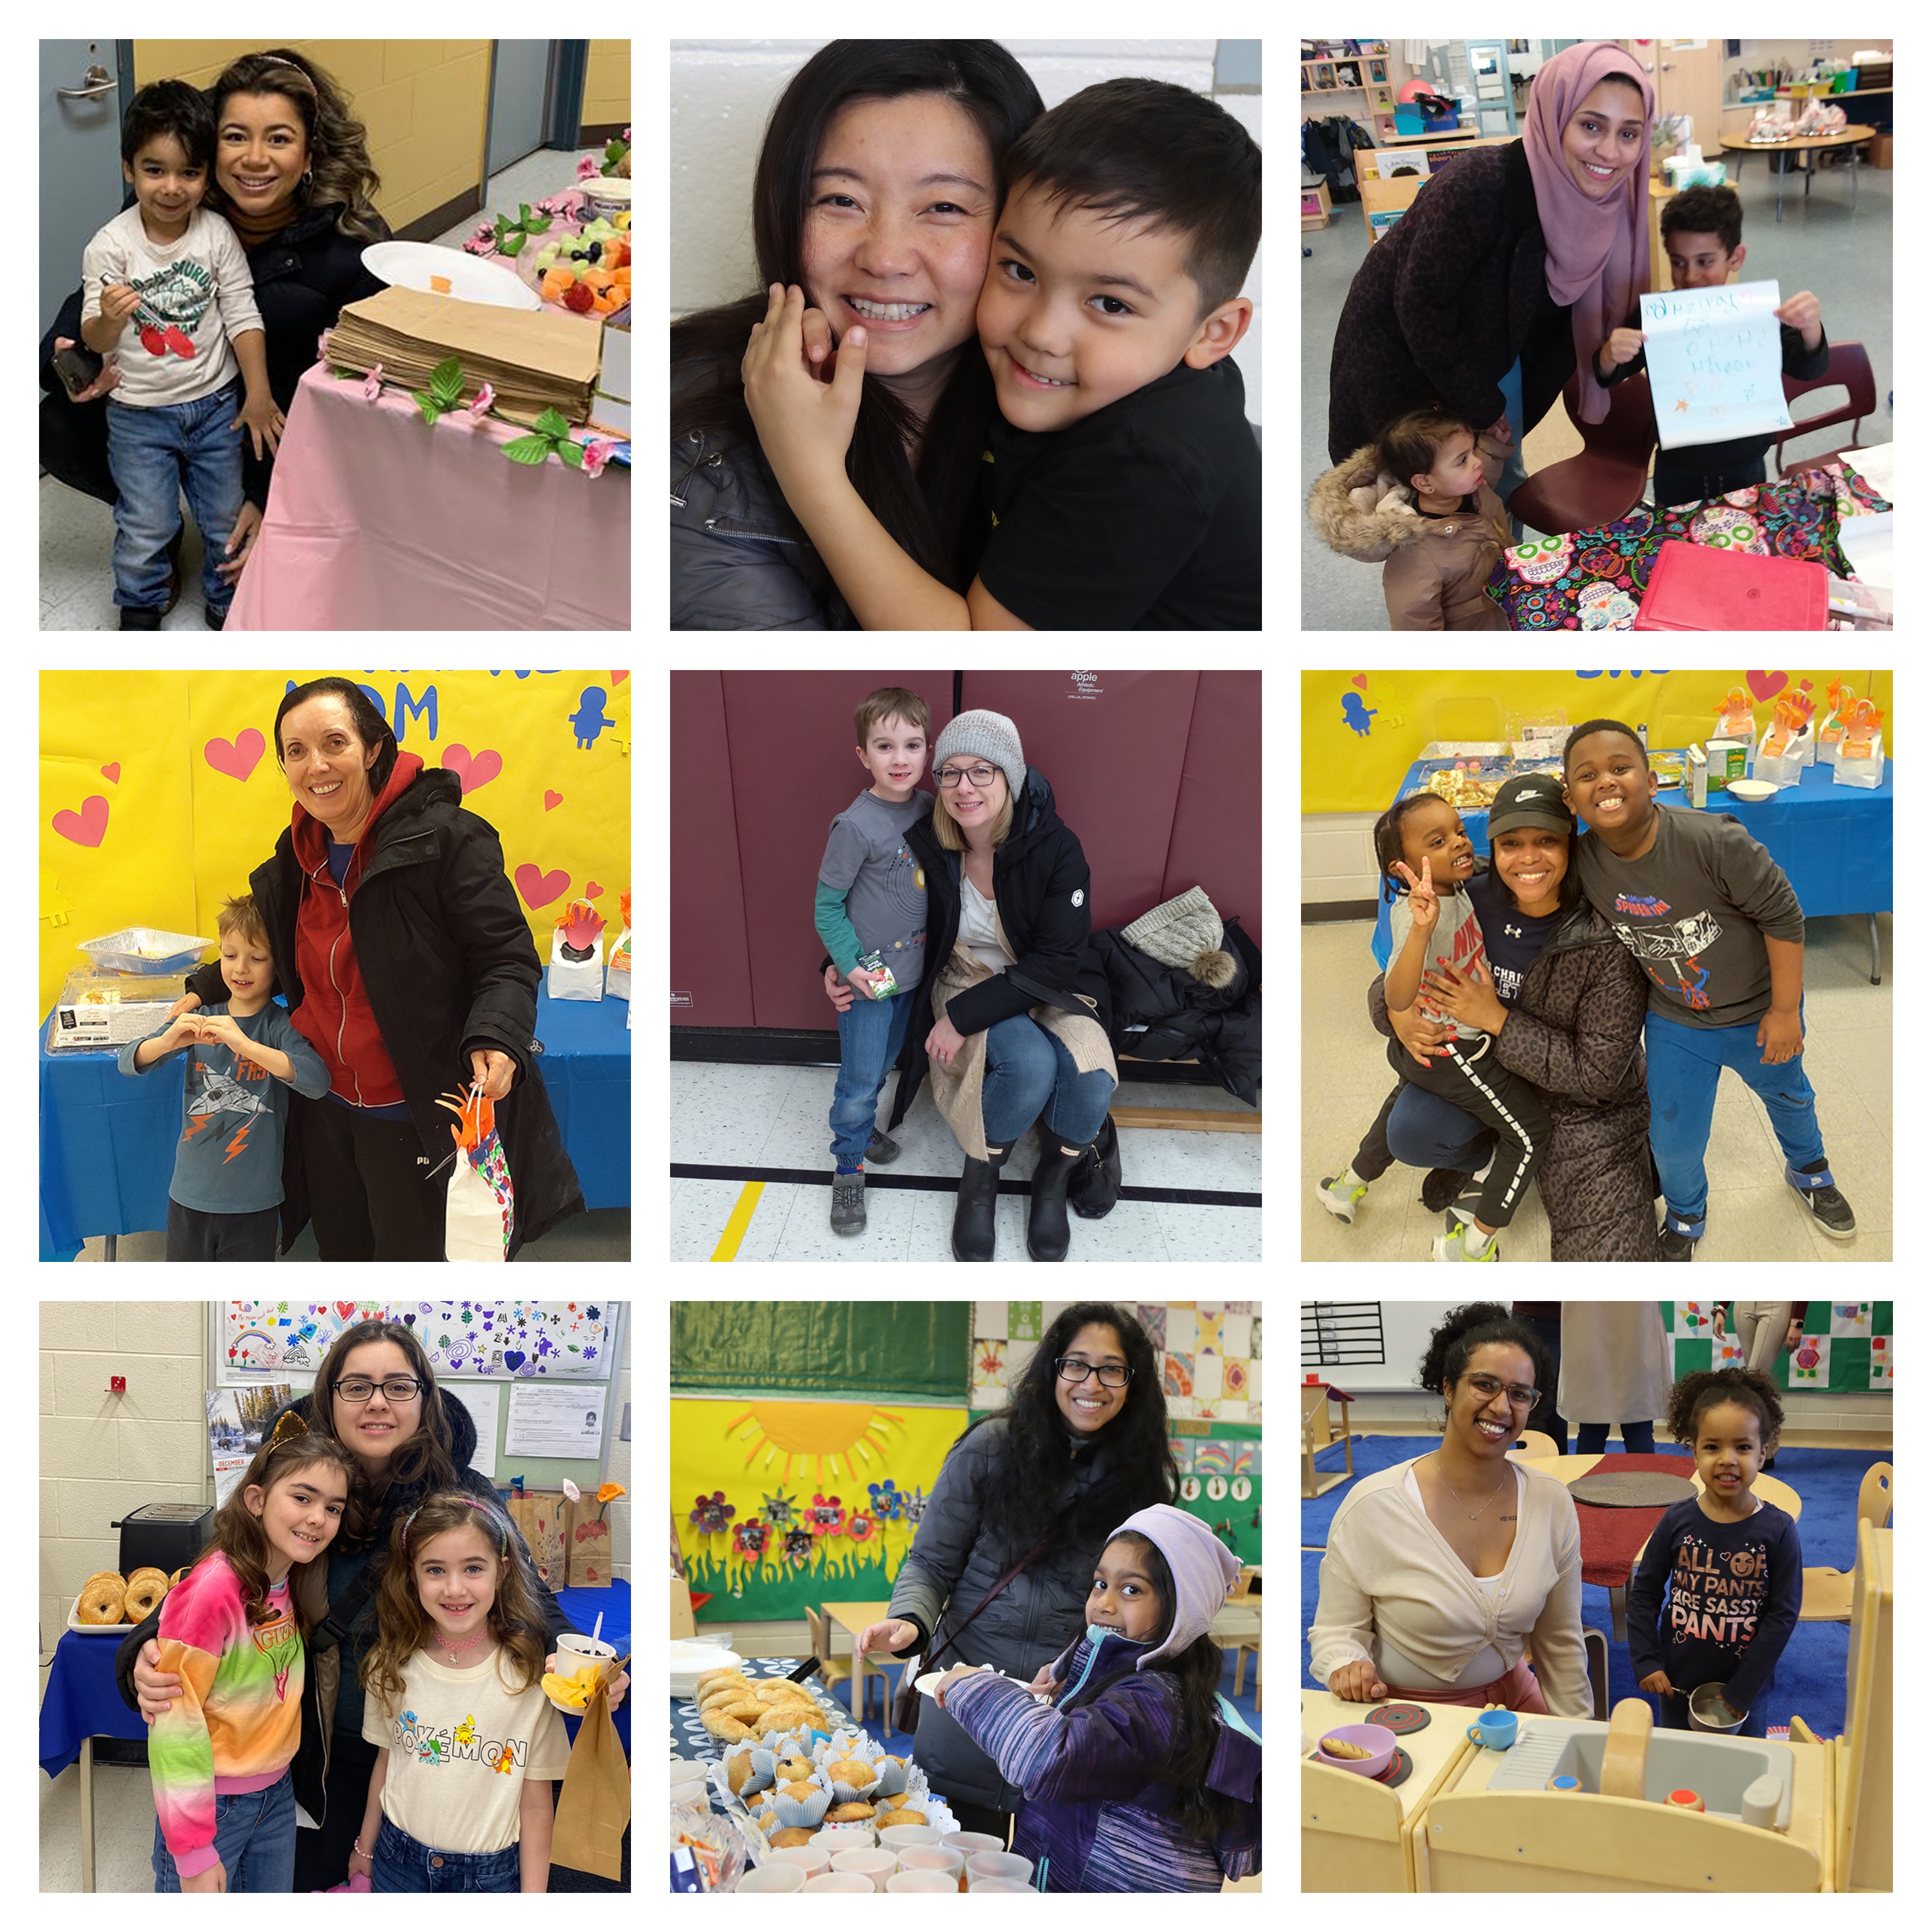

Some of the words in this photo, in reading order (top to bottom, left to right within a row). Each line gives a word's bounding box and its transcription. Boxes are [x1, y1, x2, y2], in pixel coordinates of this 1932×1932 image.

[1071, 672, 1097, 682] apple
[236, 1061, 270, 1081] FAS
[1678, 1545, 1720, 1574] ALL
[1676, 1570, 1701, 1591] MY
[1704, 1576, 1764, 1597] PANTS
[1672, 1589, 1701, 1611] ARE
[1704, 1597, 1762, 1615] SASSY
[1671, 1605, 1759, 1643] PANTS
